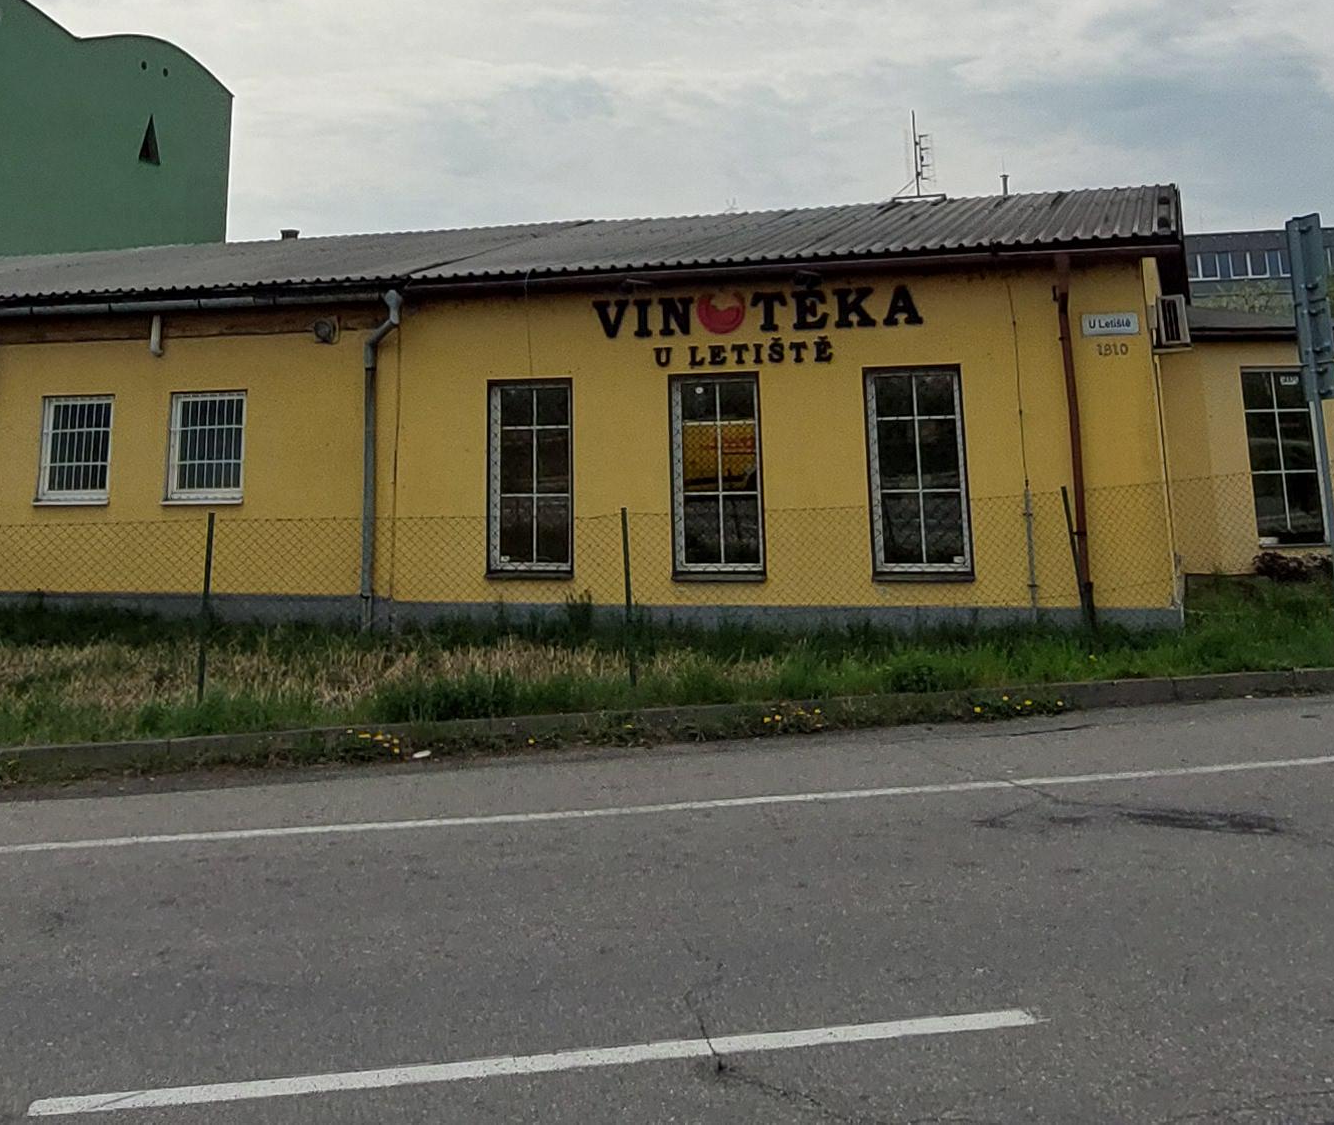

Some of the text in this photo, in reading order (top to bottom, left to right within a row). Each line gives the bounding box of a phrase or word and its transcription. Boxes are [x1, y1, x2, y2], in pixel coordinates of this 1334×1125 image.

[1088, 319, 1096, 329] U
[653, 336, 834, 369] U LETIŠTĚ
